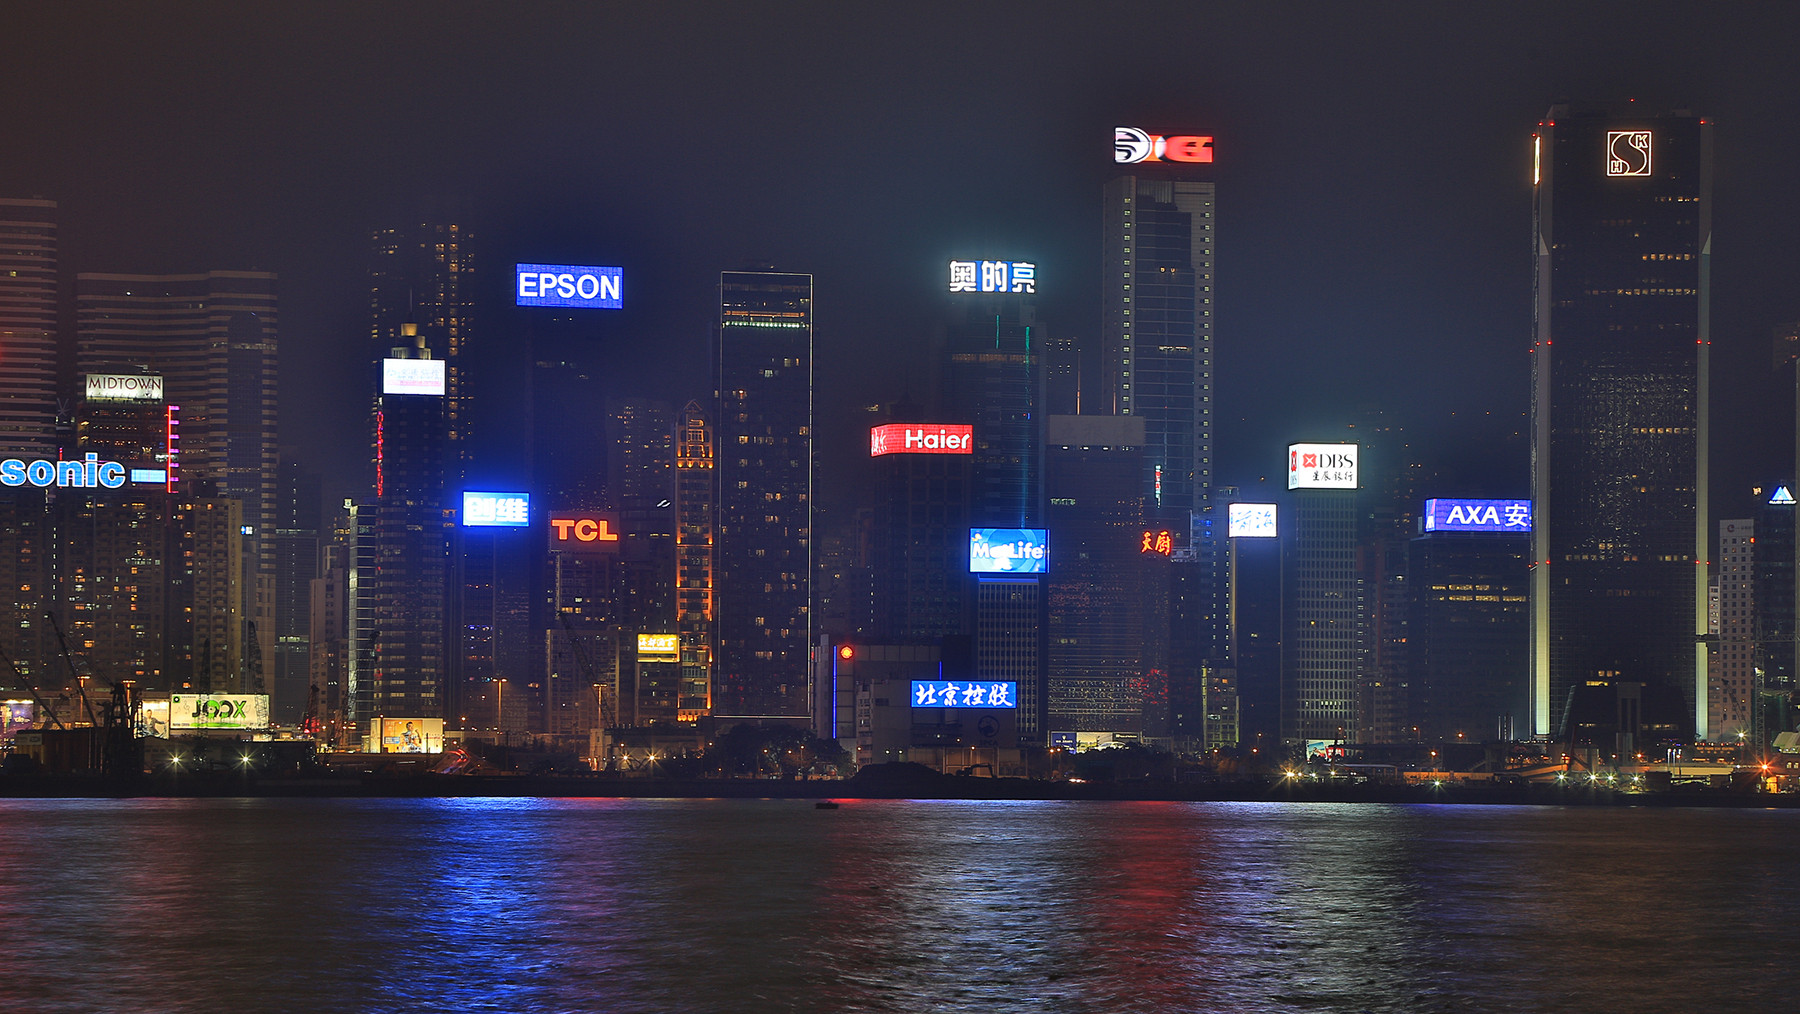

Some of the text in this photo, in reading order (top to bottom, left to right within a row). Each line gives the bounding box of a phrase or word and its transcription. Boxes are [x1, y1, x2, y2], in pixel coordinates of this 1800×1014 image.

[519, 272, 620, 300] EPSON
[88, 376, 161, 390] MIDTOWN
[904, 429, 971, 449] Haier
[1319, 453, 1354, 468] DBS
[1446, 505, 1501, 525] AXA
[1504, 503, 1533, 527] 安
[551, 519, 618, 541] TCL
[915, 682, 1013, 706] 北京控股
[192, 699, 247, 719] JOOX
